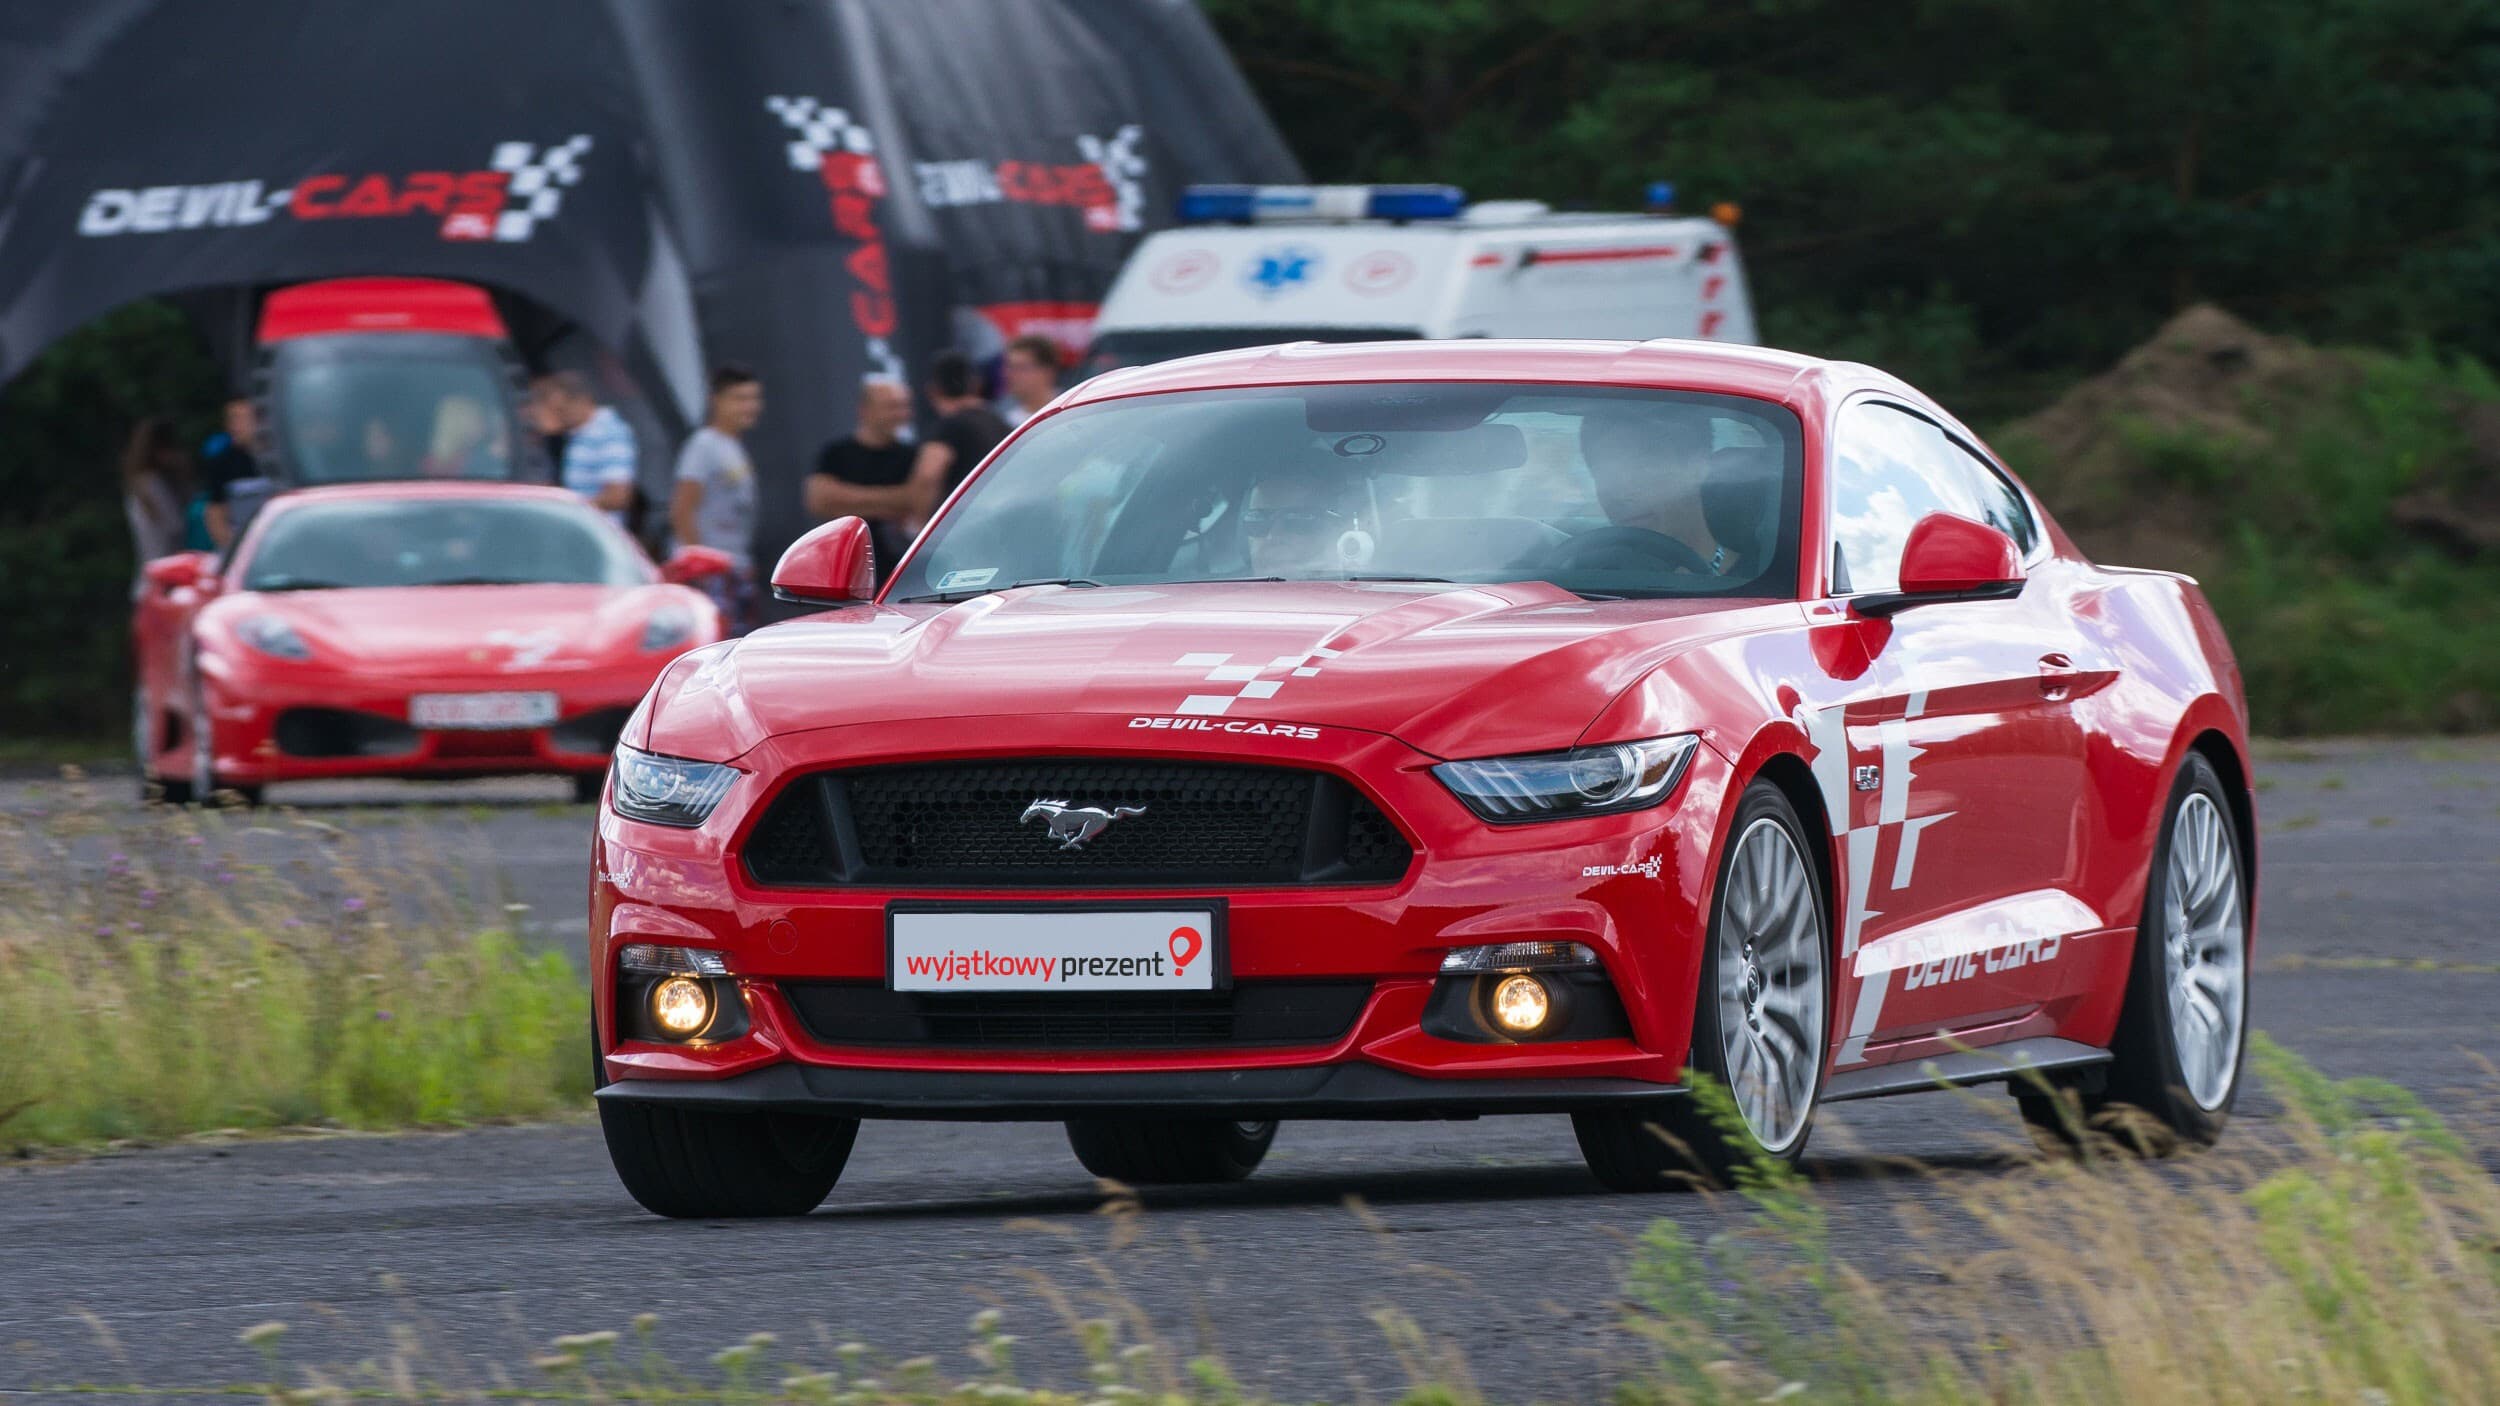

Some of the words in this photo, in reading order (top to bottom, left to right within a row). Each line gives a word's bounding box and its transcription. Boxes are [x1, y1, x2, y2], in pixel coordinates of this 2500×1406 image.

[78, 170, 510, 236] DEVIL-CARS
[1128, 717, 1321, 740] DEVIL-CARS
[1582, 863, 1653, 877] DEVIL-CARS
[907, 950, 1056, 982] wyjątkowy
[1061, 951, 1164, 982] prezent
[1903, 918, 2063, 991] DEVIL-CARS
